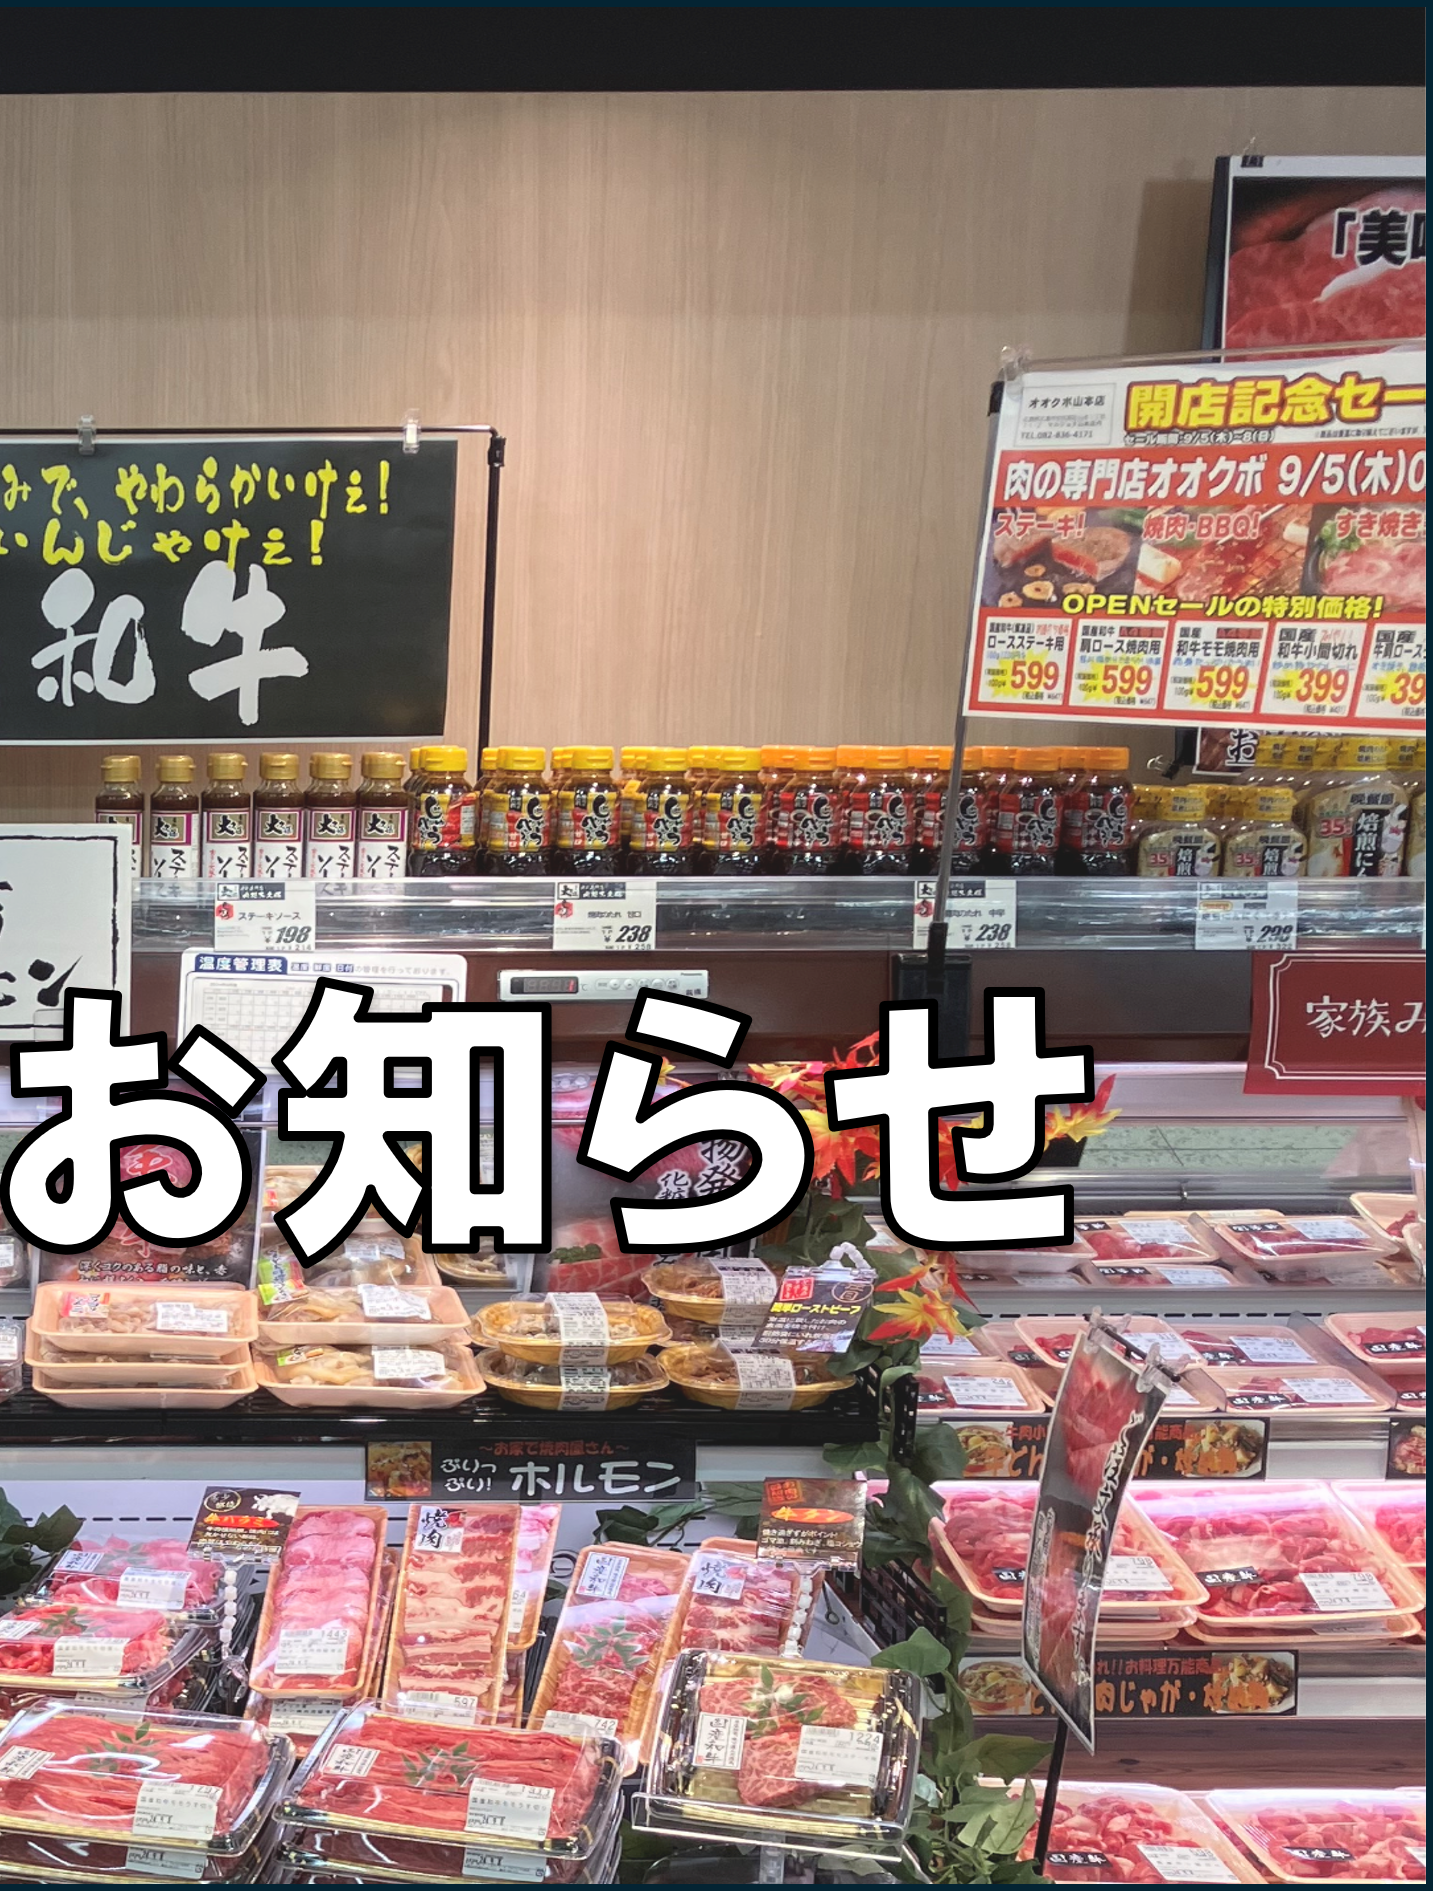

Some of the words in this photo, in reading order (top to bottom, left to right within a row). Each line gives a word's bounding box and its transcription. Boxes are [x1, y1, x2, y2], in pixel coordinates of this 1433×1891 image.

[1003, 452, 1265, 502] 肉の専門店オオクボ
[994, 512, 1085, 539] ステーキ!
[1062, 594, 1384, 620] OPENセールの特別価格!
[1080, 625, 1115, 637] 国産和牛
[1179, 627, 1203, 639] 国産
[1278, 628, 1317, 643] 国産
[1375, 629, 1417, 644] 国産
[987, 635, 1065, 652] ロースステーキ用
[1079, 638, 1162, 655] 肩ロース焼肉用
[1175, 640, 1260, 658] 和牛モモ焼肉用
[1373, 643, 1426, 659] 牛肩ロース
[1010, 660, 1060, 691] 599
[1101, 664, 1154, 695] 599
[1196, 665, 1250, 700] 599
[1295, 668, 1350, 704] 399
[237, 911, 302, 921] ステーキソース
[275, 925, 312, 943] 198
[616, 925, 652, 943] 238
[975, 923, 1012, 941] 238
[198, 956, 283, 973] 温度管理表
[770, 1302, 862, 1315] 簡単ローストビーフ
[440, 1458, 497, 1474] ぷりっ
[509, 1459, 683, 1496] ホルモン
[204, 1513, 265, 1527] 牛ハラミ
[775, 1506, 842, 1521] 牛タン
[419, 1509, 450, 1550] 焼肉
[698, 1560, 728, 1594] 焼肉
[594, 1719, 616, 1731] 742
[704, 1717, 729, 1763] 国産和牛
[849, 1732, 881, 1745] 1224
